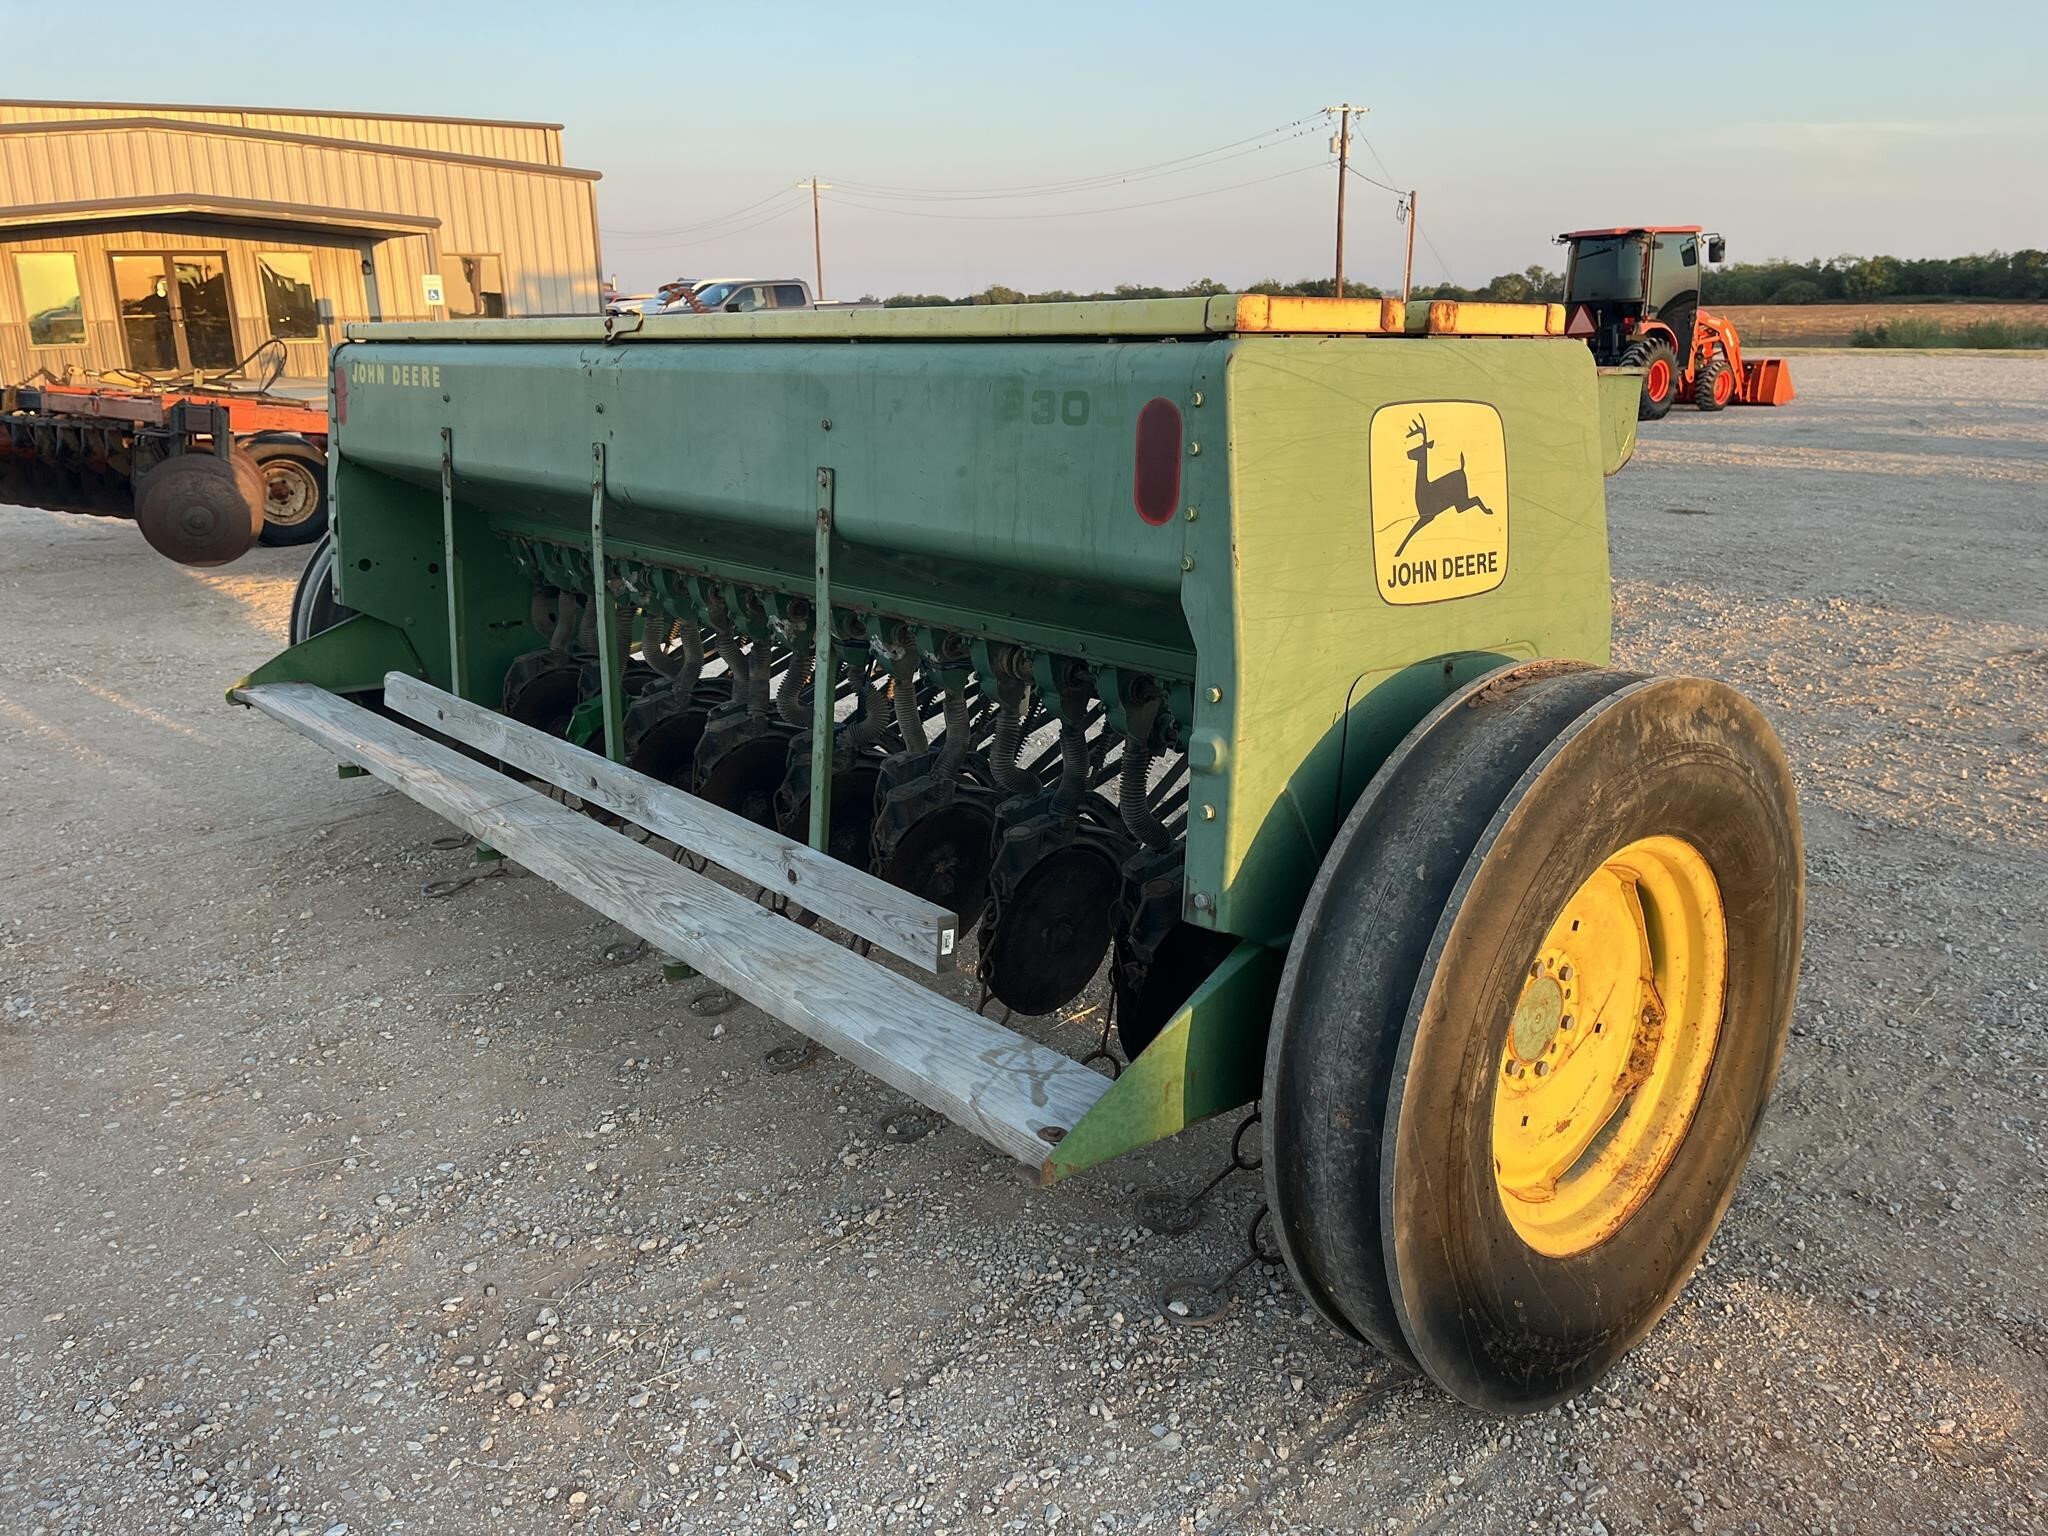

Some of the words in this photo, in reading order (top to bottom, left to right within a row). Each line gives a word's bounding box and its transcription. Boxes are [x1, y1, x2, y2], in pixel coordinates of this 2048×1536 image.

[352, 363, 385, 384] JOHN
[392, 365, 440, 387] DEERE
[1387, 559, 1437, 588] JOHN
[1442, 551, 1498, 580] DEERE
